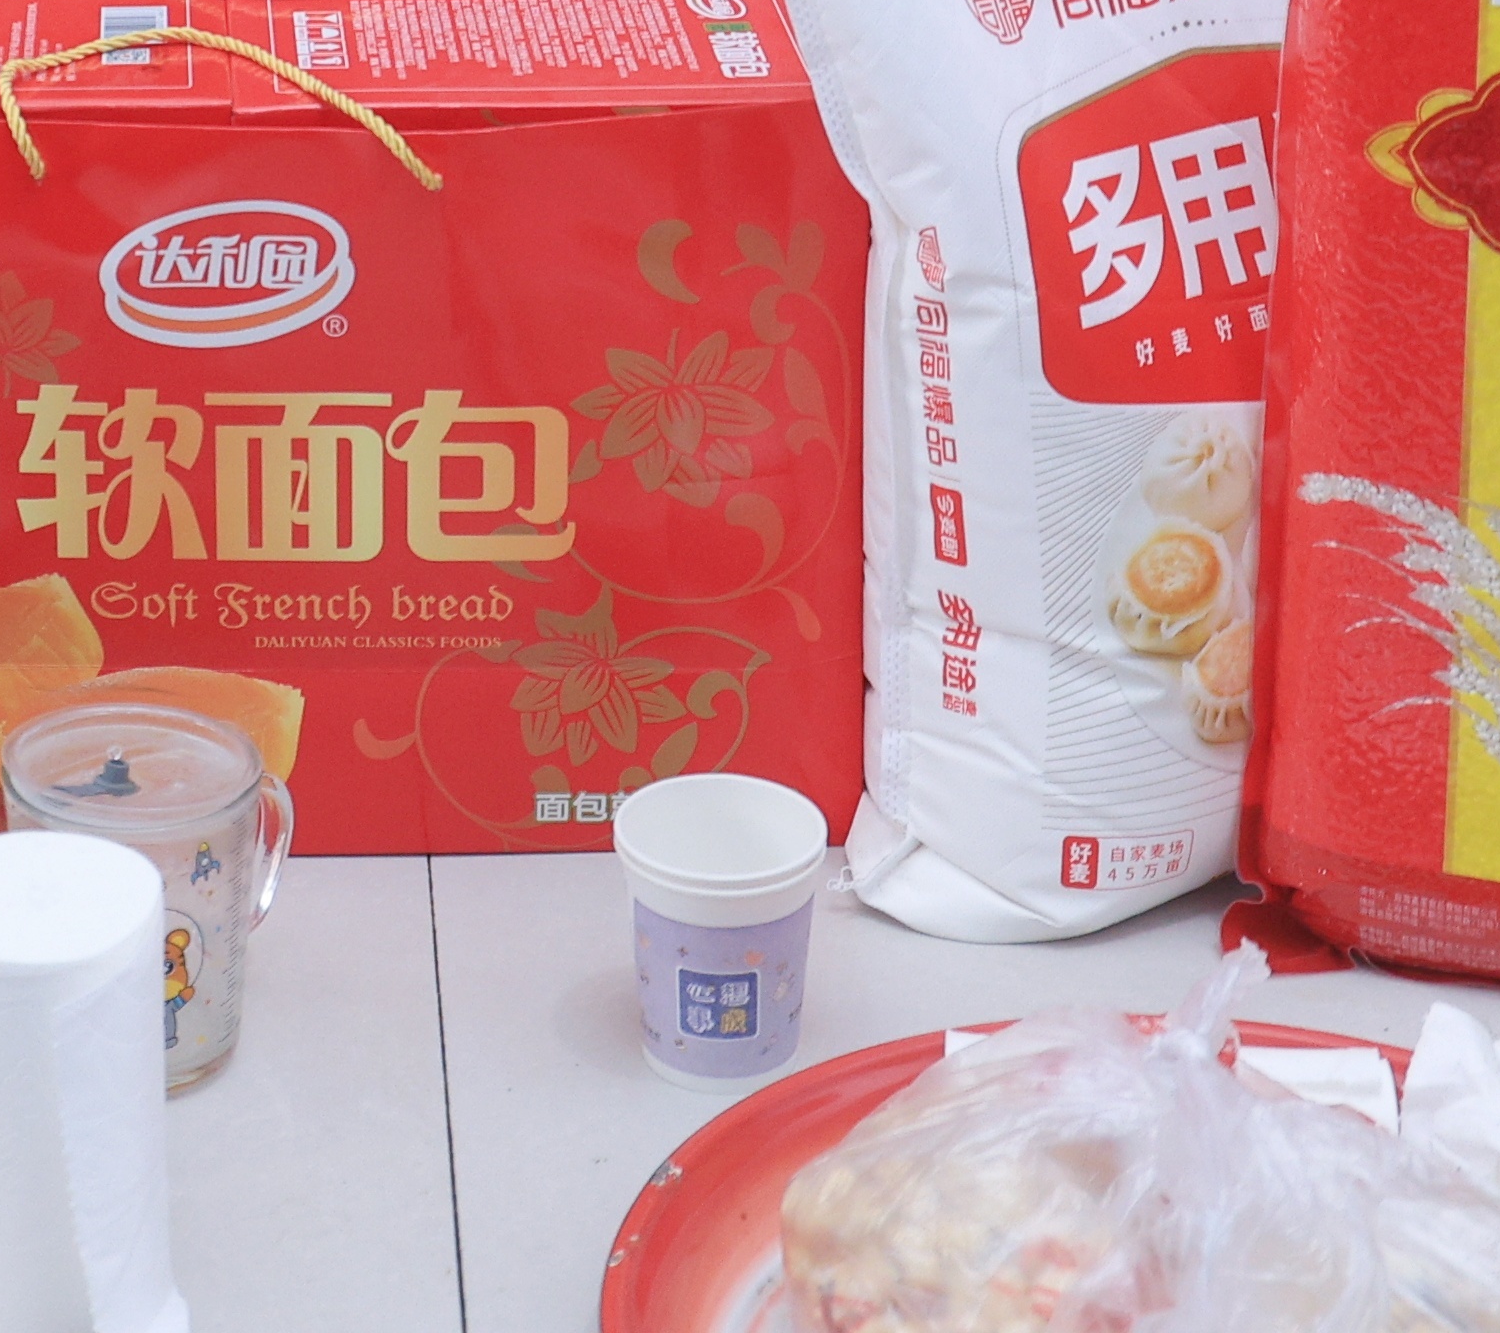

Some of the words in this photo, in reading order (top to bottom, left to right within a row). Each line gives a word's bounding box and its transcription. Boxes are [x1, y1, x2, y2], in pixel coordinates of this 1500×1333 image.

[1062, 116, 1280, 331] 多用
[133, 233, 318, 291] 达利园
[913, 293, 958, 468] 同福爆品
[16, 383, 576, 564] 软面包
[90, 580, 199, 621] Soft
[213, 580, 372, 629] French
[391, 582, 515, 621] bread
[253, 635, 348, 649] DALIYUAN
[352, 635, 437, 649] CLASSICS
[439, 635, 503, 649] FOODS
[937, 588, 983, 694] 多用途
[1068, 841, 1092, 885] 好麦
[1110, 838, 1185, 863] 自家麦场
